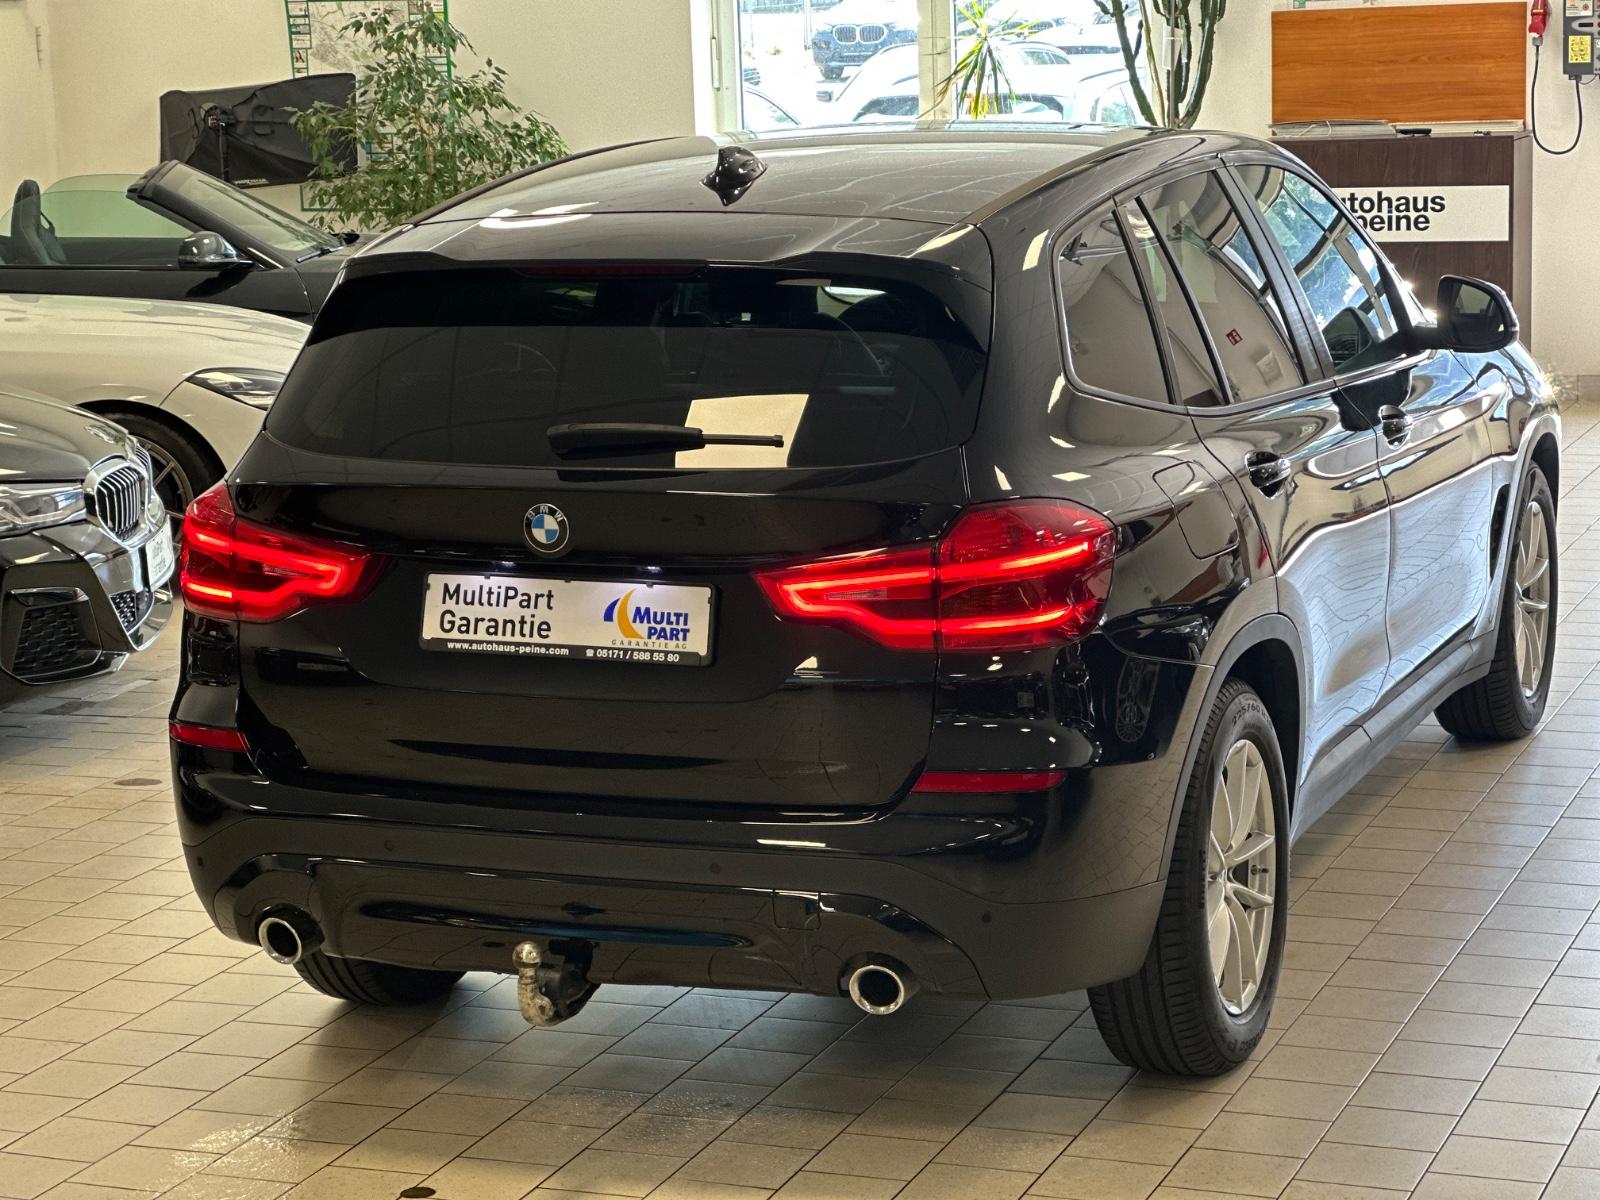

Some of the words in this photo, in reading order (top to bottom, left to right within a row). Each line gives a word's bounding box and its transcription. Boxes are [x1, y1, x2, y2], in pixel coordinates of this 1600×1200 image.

[527, 505, 564, 522] BMW
[442, 583, 554, 610] MultiPart
[439, 609, 552, 639] Garantie
[647, 626, 690, 641] PART
[447, 641, 569, 655] www.autohaus-peine.com
[611, 639, 669, 649] GARANTIE
[596, 649, 624, 659] 05171
[632, 651, 651, 661] 588
[652, 652, 665, 661] 55
[667, 653, 680, 662] 80
